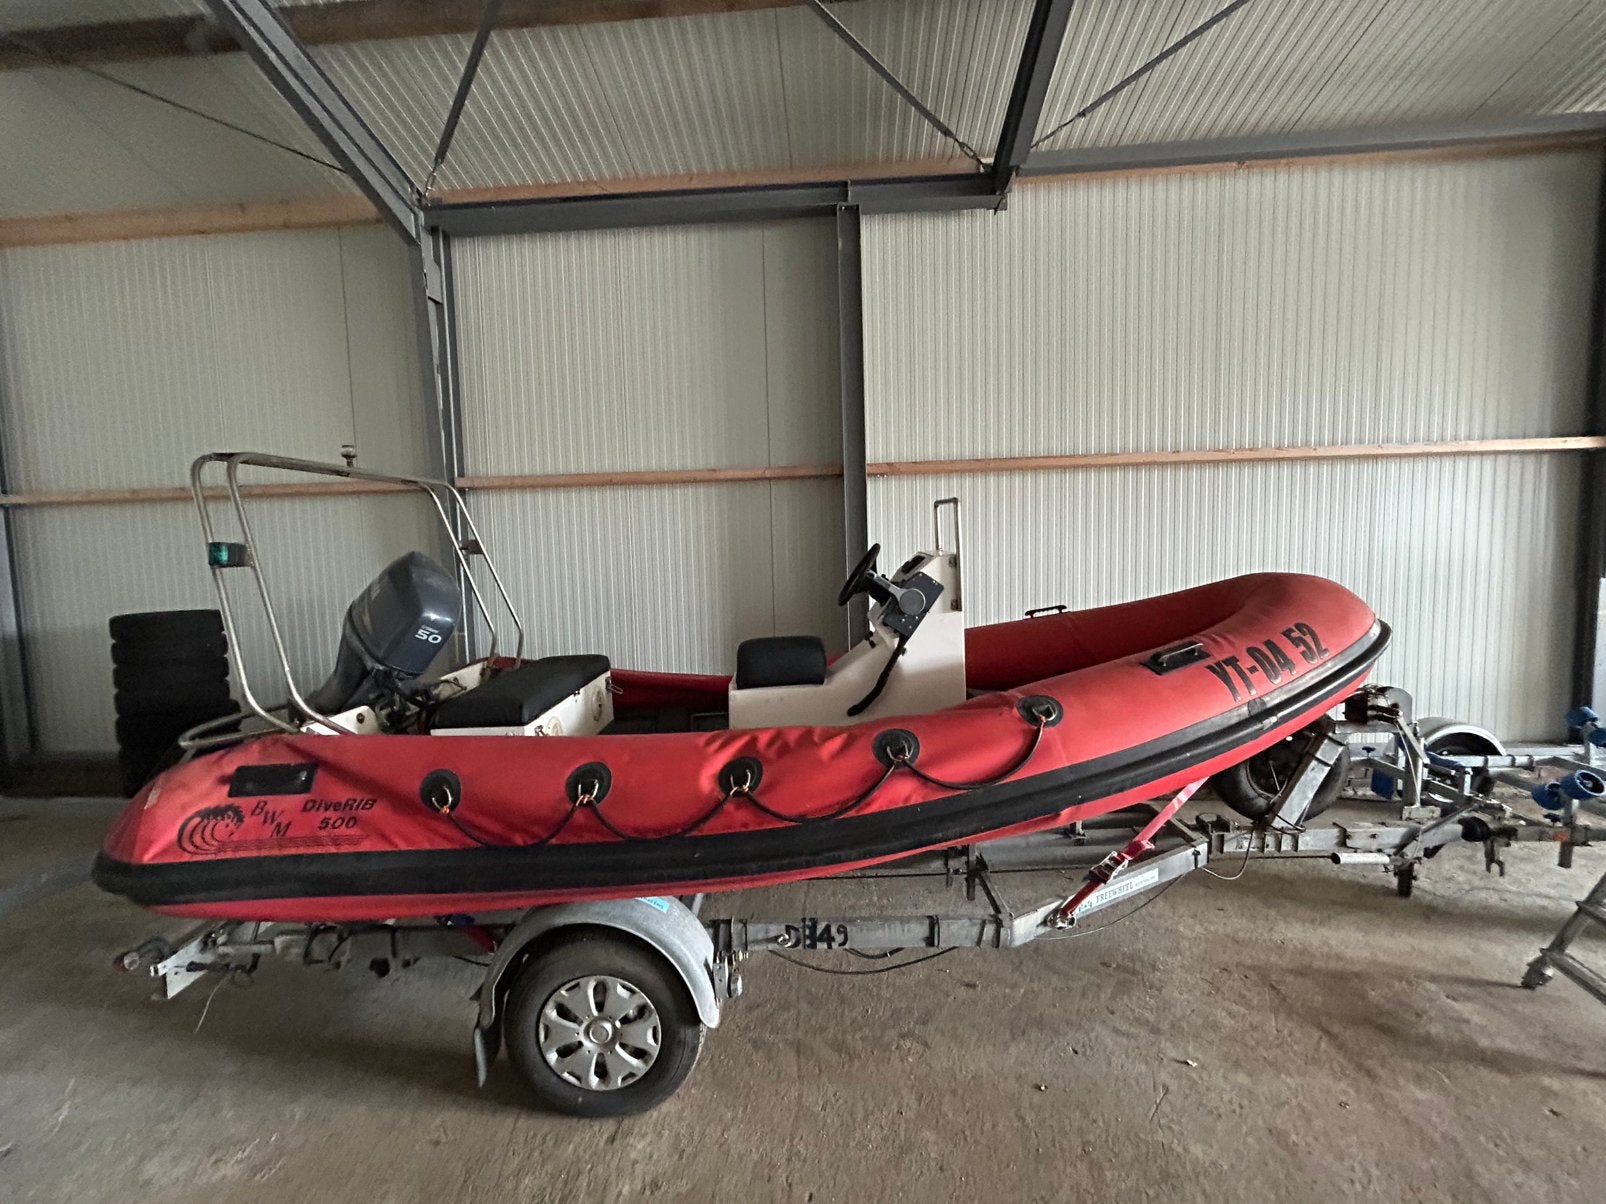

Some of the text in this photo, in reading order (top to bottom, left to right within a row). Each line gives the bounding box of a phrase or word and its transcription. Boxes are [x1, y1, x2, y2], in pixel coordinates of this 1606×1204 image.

[414, 628, 442, 644] 50
[1281, 622, 1330, 664] 52
[301, 798, 378, 813] DiveRIB
[317, 816, 358, 831] 500
